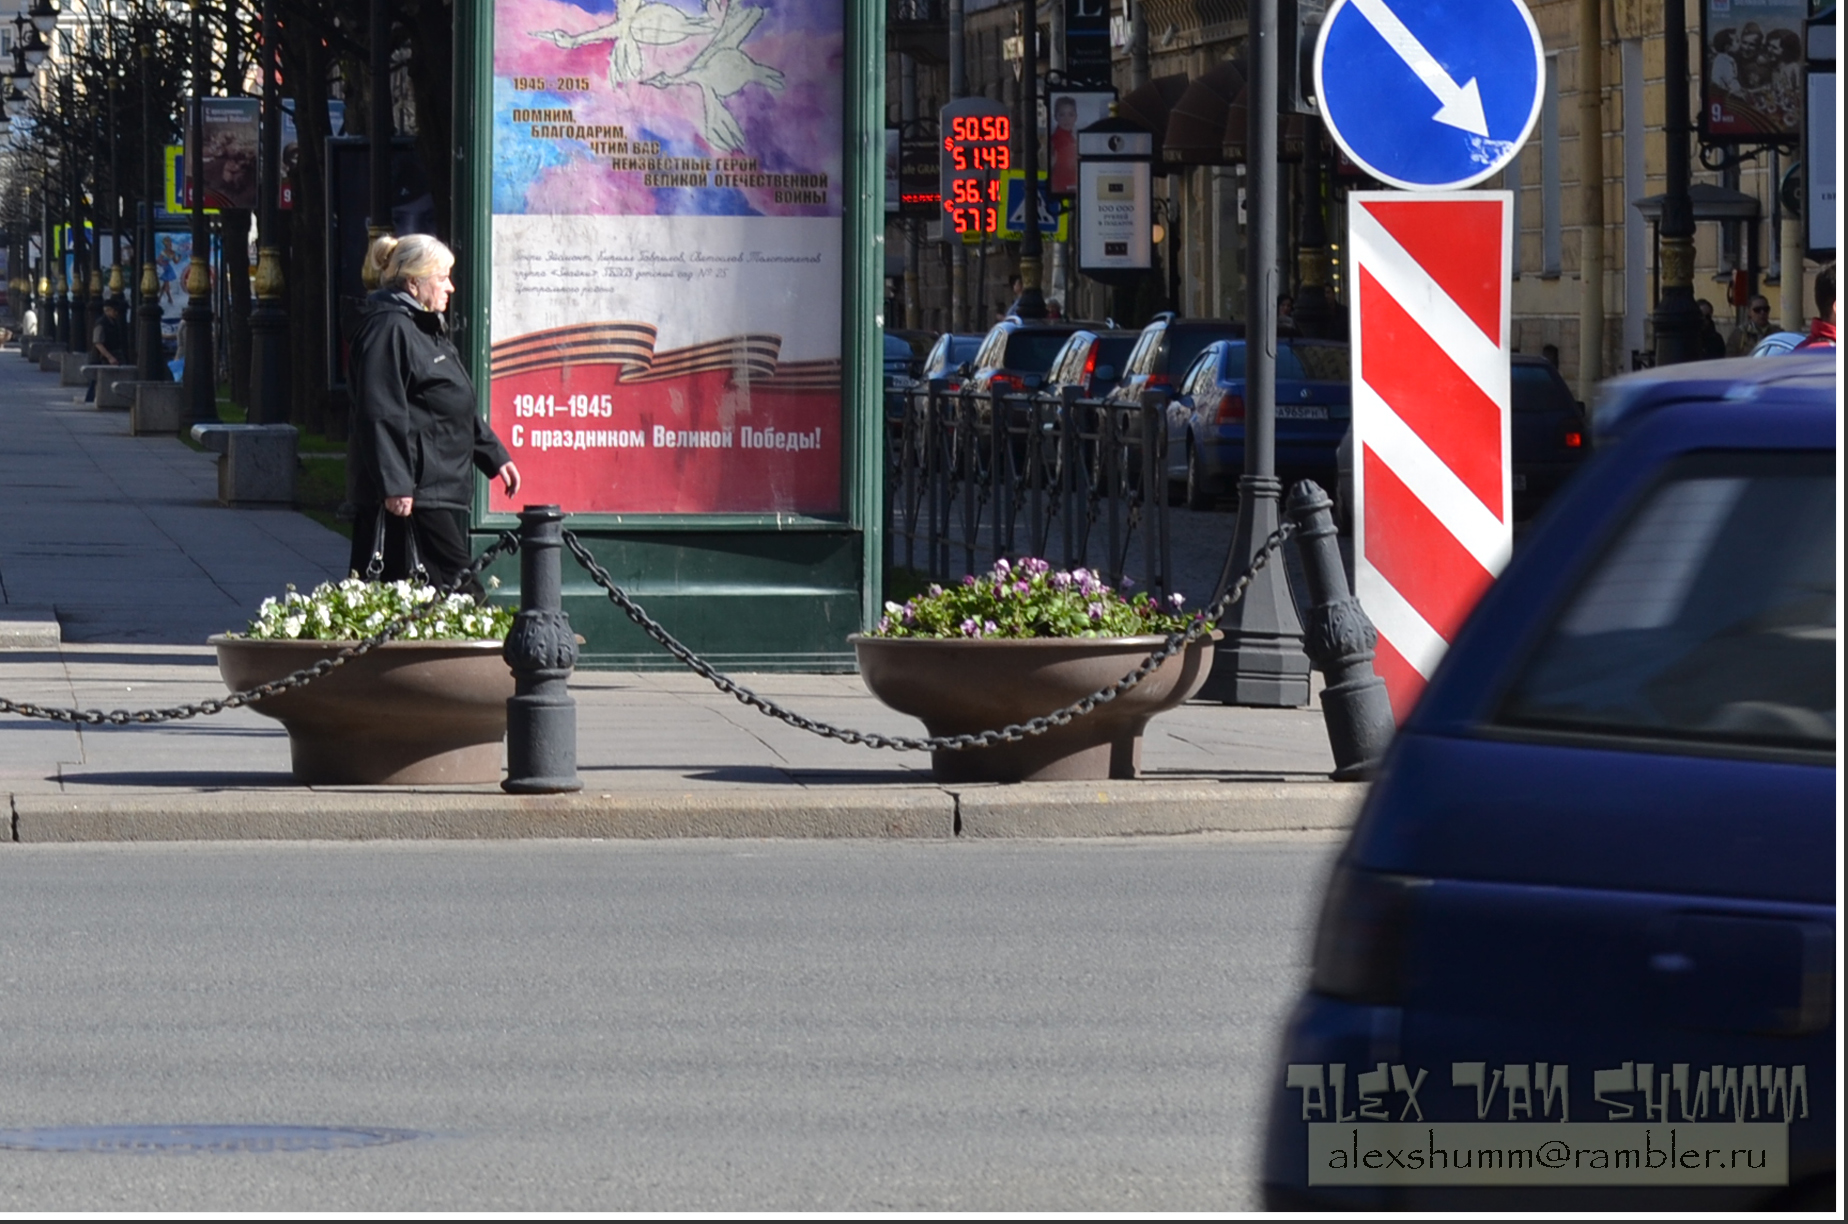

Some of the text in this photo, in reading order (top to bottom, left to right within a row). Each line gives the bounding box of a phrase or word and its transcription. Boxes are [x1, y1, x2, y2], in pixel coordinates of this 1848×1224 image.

[513, 77, 546, 91] 1945
[557, 77, 590, 91] 2015
[512, 109, 577, 124] ПОМНИМ,
[1711, 103, 1722, 122] 9
[531, 125, 628, 140] БЛАГОДАРИМ,
[953, 116, 1010, 141] 50.50
[590, 141, 629, 155] ЧТИМ
[612, 157, 758, 172] НЕИЗВЕСТНЫЕ ГЕРОИ
[953, 145, 1010, 171] 51.43
[643, 172, 829, 188] ВЕЛИКОЙ ОТЕЧЕСТВЕННОЙ
[774, 189, 827, 204] ВОЙНЫ
[511, 425, 822, 452] С праздником Великой Победы!
